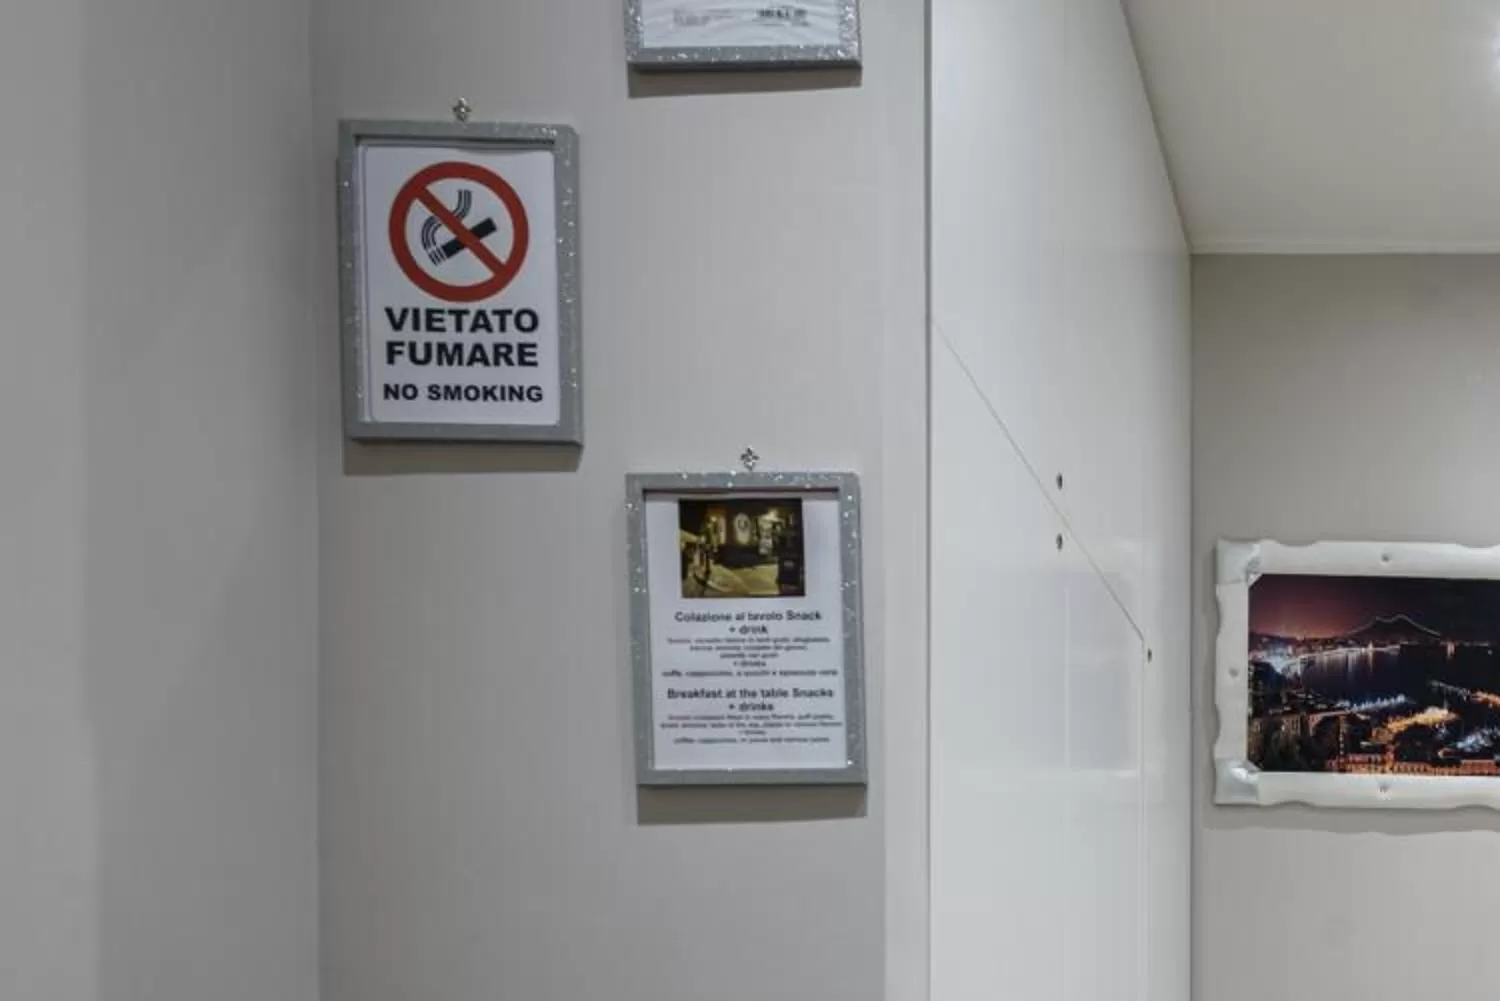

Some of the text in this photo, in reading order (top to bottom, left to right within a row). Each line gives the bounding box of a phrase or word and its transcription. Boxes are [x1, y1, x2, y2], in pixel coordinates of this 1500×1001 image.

[384, 307, 539, 333] VIETATO
[385, 341, 539, 367] FUMARE
[383, 383, 543, 403] NO SMOKING
[674, 611, 732, 622] Colazione
[748, 611, 784, 621] tavolo
[786, 609, 823, 621] Snack
[667, 687, 834, 699] Breakfast at the table Snacks
